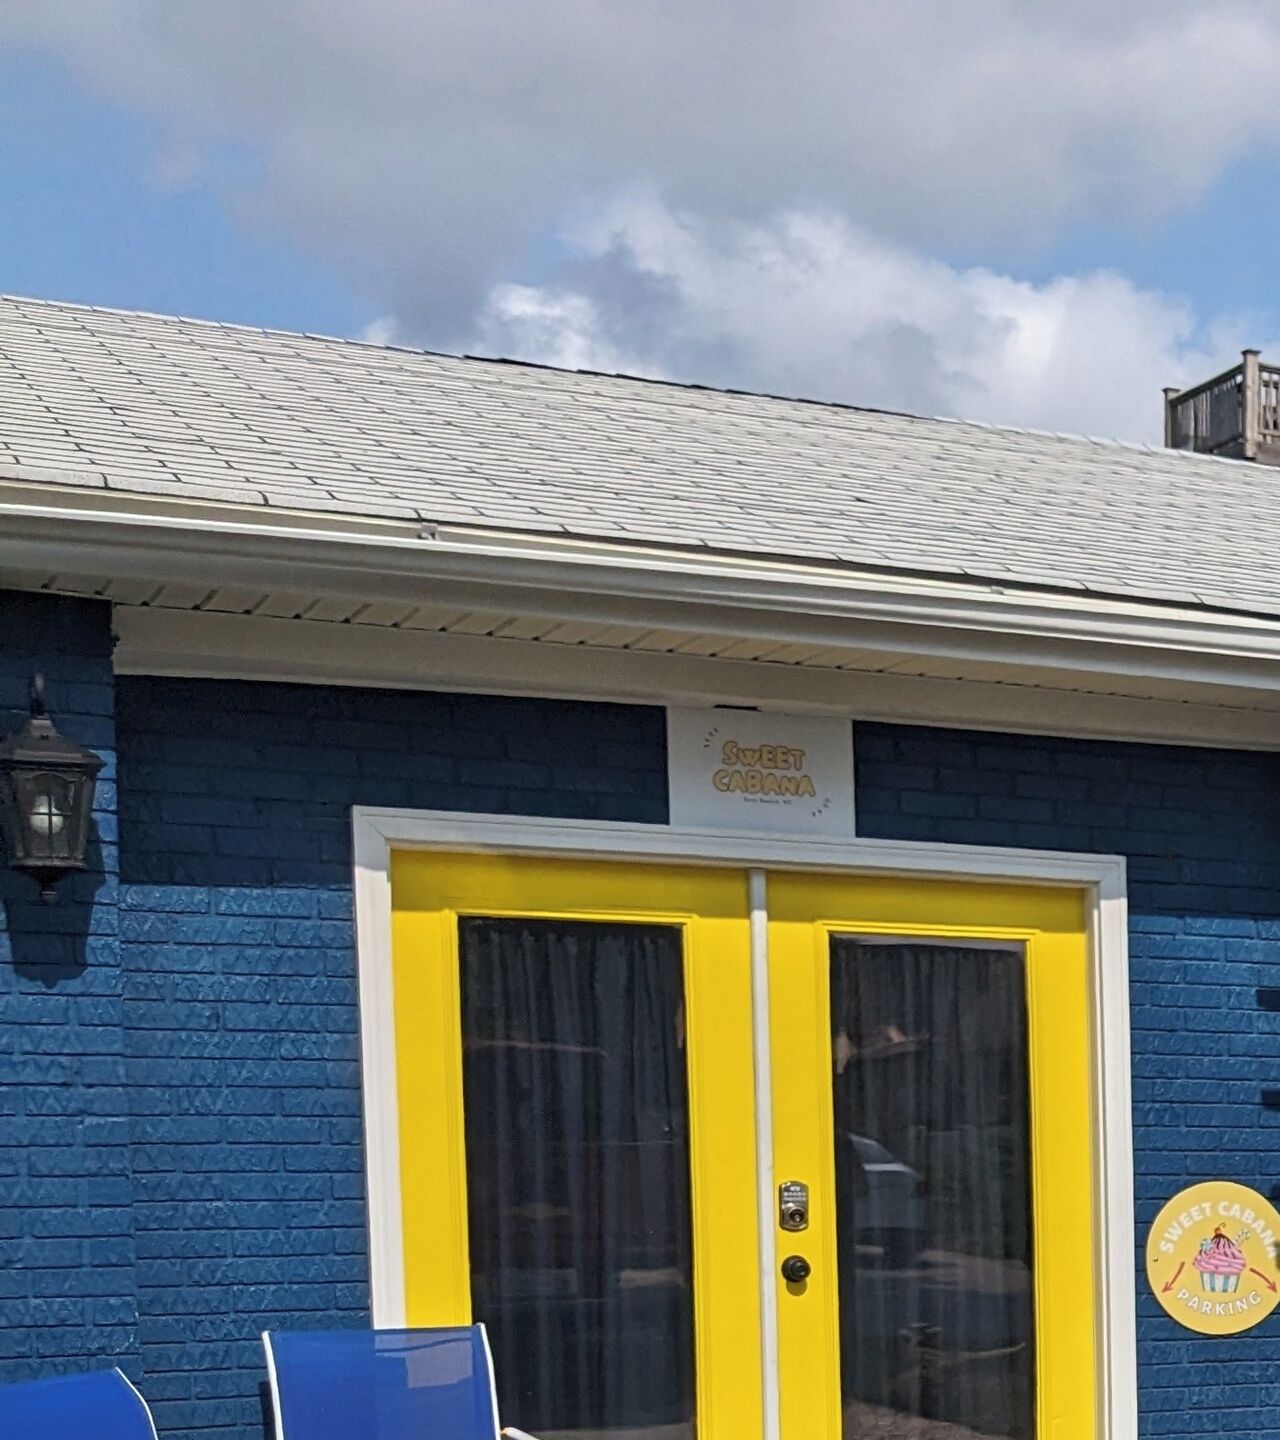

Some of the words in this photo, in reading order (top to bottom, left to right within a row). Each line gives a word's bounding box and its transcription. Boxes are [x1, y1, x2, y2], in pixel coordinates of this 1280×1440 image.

[722, 740, 806, 771] SWEET
[712, 768, 816, 797] CABANA
[1160, 1201, 1212, 1254] SWEET
[1217, 1201, 1278, 1259] CABANA
[1177, 1288, 1263, 1316] PARKING
